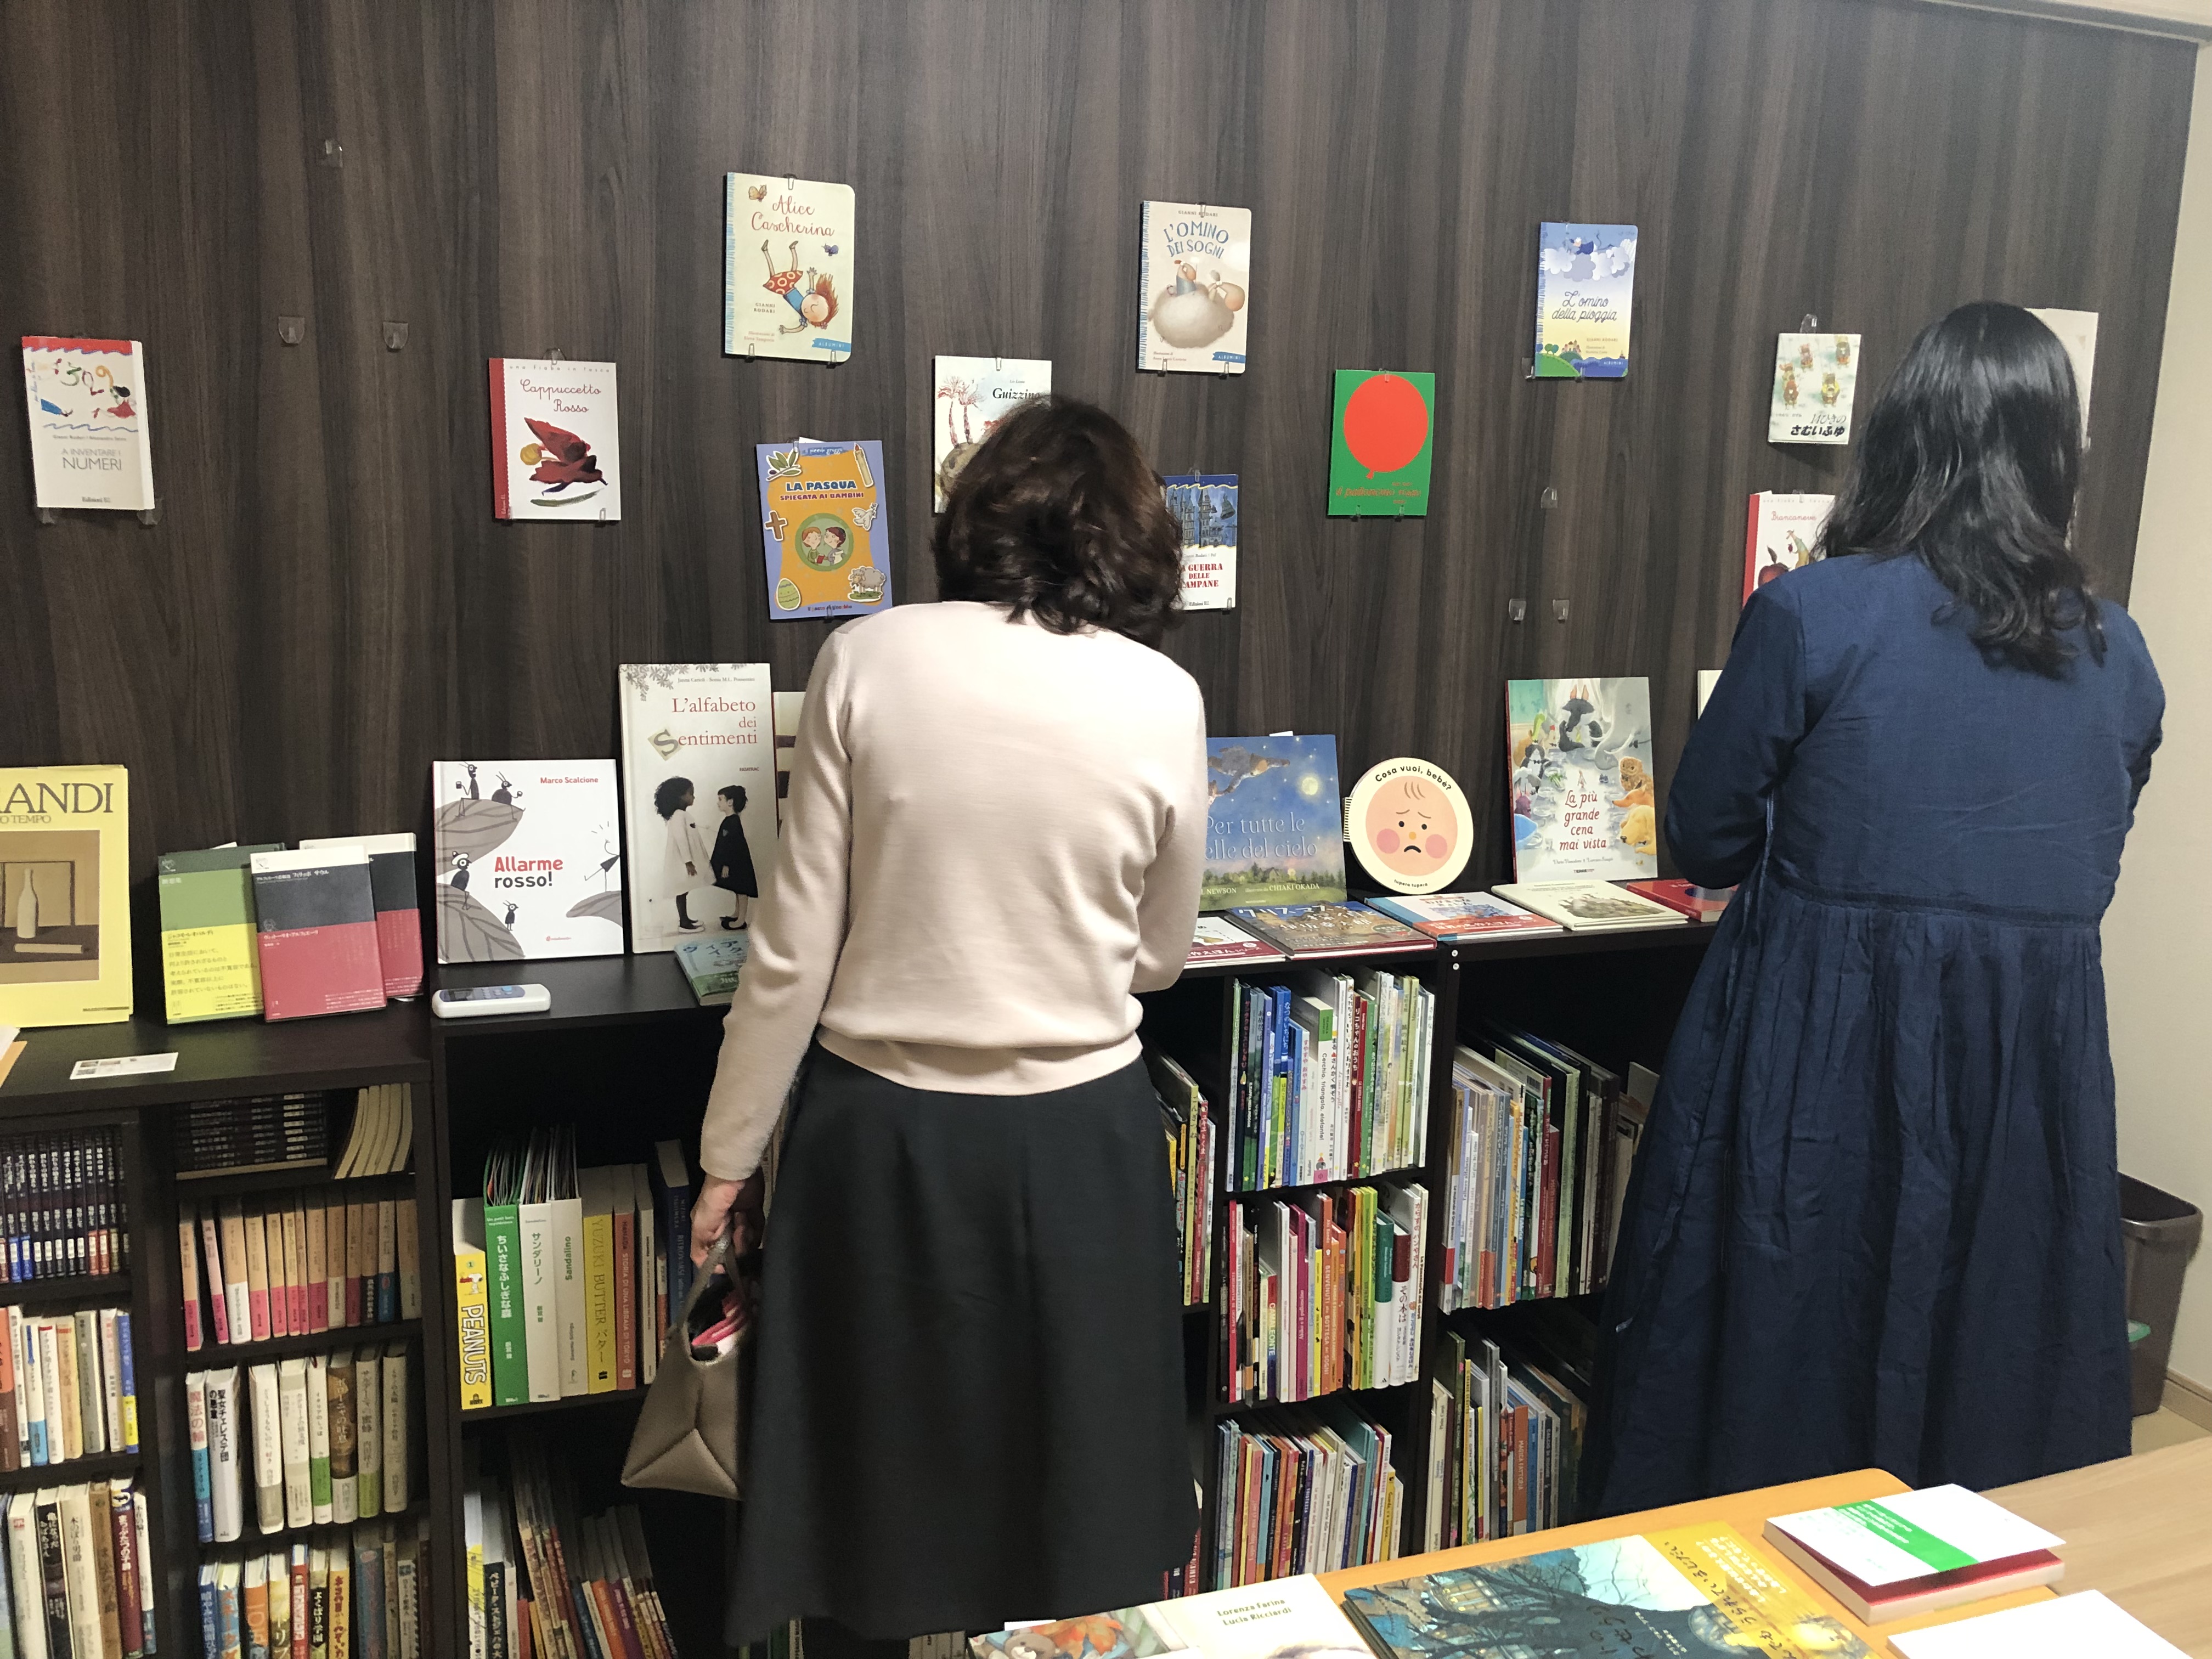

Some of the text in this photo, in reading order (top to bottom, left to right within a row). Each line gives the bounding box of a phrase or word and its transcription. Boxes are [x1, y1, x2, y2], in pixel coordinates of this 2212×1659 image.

[772, 195, 815, 215] Alice
[752, 212, 834, 236] Cascherina
[1164, 221, 1229, 244] L'OMINO
[1167, 239, 1224, 259] DEI SOGNI
[1562, 291, 1609, 307] L'omino
[1551, 308, 1617, 323] della pioggia
[520, 379, 601, 400] Cappuccetto
[554, 399, 589, 412] Rosso
[1810, 414, 1847, 425] 14ひきの
[1791, 425, 1845, 437] さむいふゆ
[63, 458, 122, 470] NUMERI
[786, 480, 856, 492] LA PASQUA
[1771, 511, 1817, 521] Biancaneve
[672, 697, 756, 713] L'alfabeto
[738, 716, 757, 728] dei
[653, 729, 757, 757] Sentimenti
[1375, 766, 1397, 782] Cosa
[1400, 765, 1424, 774] vuoi,
[0, 783, 113, 813] ANDI
[1565, 790, 1598, 809] La più
[11, 815, 52, 823] TEMPO
[1207, 811, 1305, 834] Per tutte le
[1564, 810, 1600, 827] grande
[1571, 825, 1593, 836] cena
[1242, 836, 1317, 859] del cielo
[1559, 838, 1607, 851] mai vista
[495, 856, 563, 872] Allarme
[495, 871, 553, 889] rosso!
[592, 1219, 604, 1272] YUZUKI
[532, 1232, 543, 1285] サンダリーノ
[594, 1273, 607, 1324] BUTTER
[1398, 1285, 1408, 1323] その本は
[461, 1304, 486, 1386] PEANUTS
[1217, 1598, 1286, 1617] Lorenza Farina
[1222, 1606, 1292, 1627] Lucia Ricciardi
